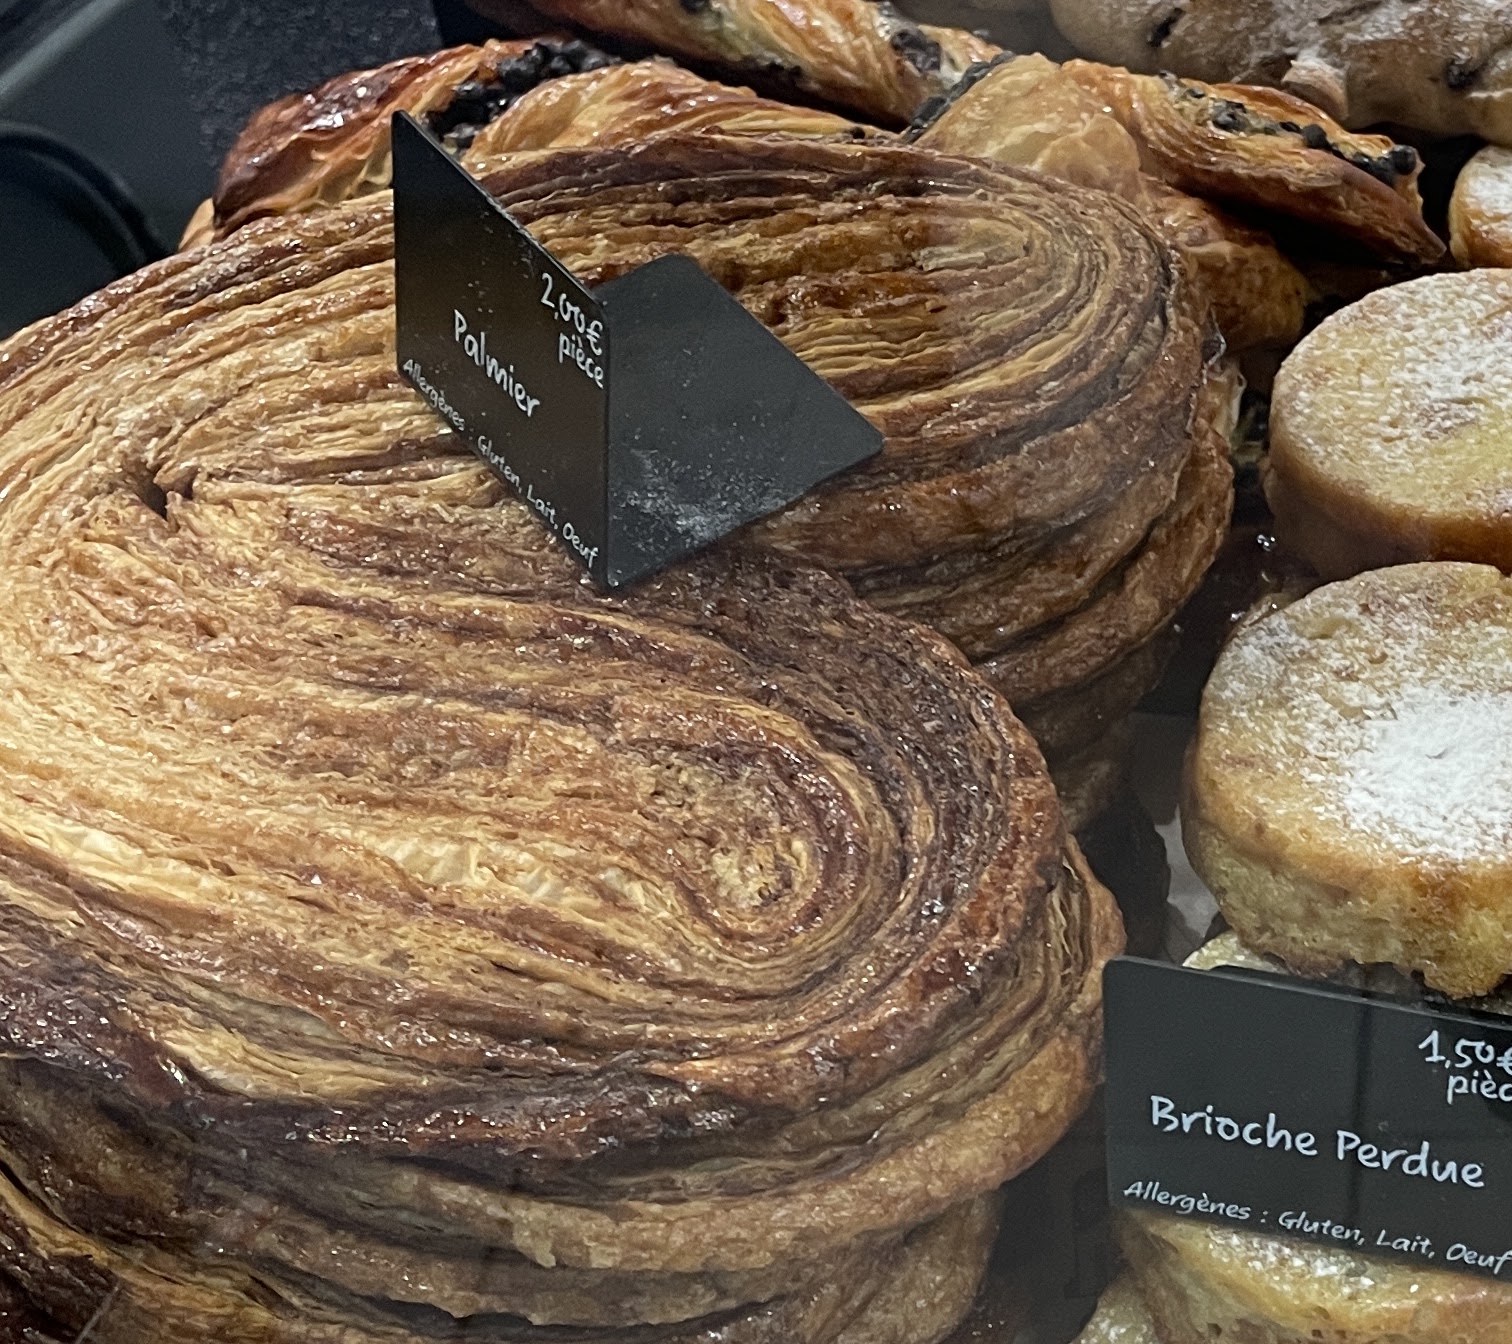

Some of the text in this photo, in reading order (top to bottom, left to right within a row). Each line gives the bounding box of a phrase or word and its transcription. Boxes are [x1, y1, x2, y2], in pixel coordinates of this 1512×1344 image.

[403, 359, 465, 431] Allergènes
[454, 308, 540, 417] Palmier
[558, 332, 604, 389] pièce
[1150, 1095, 1486, 1189] Brioche Perdue
[1124, 1181, 1251, 1221] Allergènes
[1278, 1211, 1366, 1246] Gluten,
